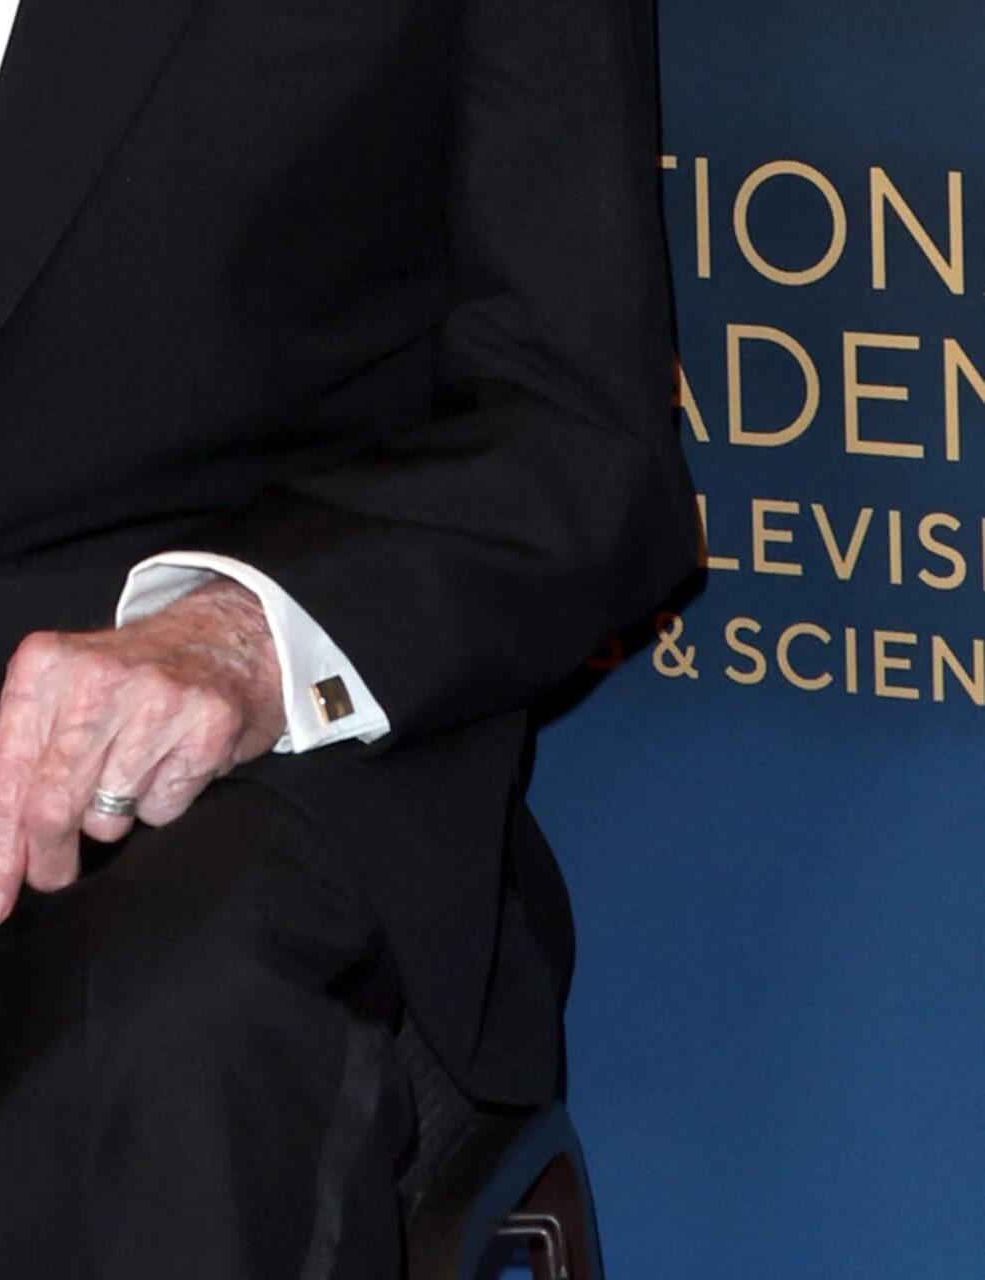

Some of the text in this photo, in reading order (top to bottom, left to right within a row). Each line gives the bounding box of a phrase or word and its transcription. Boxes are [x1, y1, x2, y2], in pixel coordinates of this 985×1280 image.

[658, 154, 964, 296] ION
[696, 493, 985, 591] LEVIS
[653, 610, 985, 706] & SCIEN
